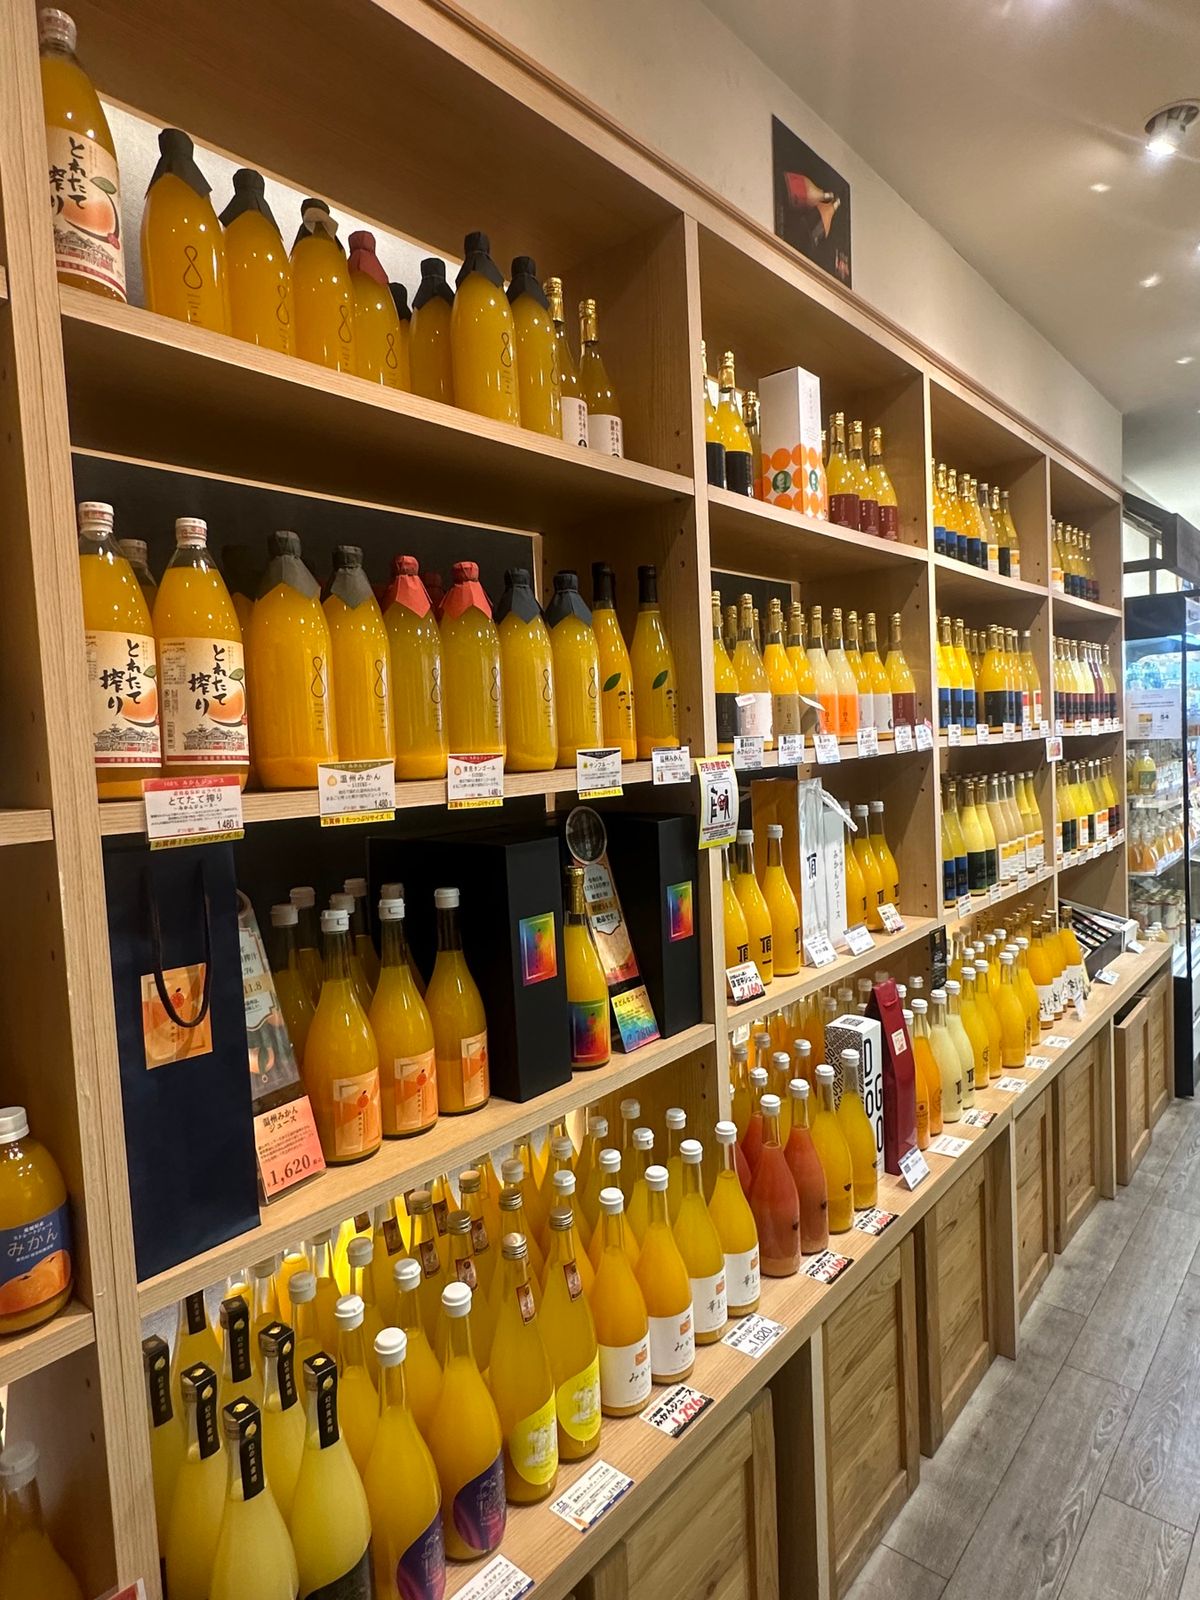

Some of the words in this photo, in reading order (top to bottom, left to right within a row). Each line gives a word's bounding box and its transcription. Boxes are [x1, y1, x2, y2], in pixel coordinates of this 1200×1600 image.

[67, 136, 88, 210] とれたて
[126, 639, 142, 705] とれたて
[212, 644, 227, 706] とれたて
[100, 668, 126, 716] 搾り
[188, 672, 212, 717] 搾り
[340, 773, 380, 783] 温州みかん
[262, 1106, 298, 1128] 温州みかん
[269, 1116, 296, 1133] ジュース
[8, 1228, 58, 1257] みかん
[748, 1326, 773, 1348] 1,620
[654, 1388, 696, 1427] みかんジュース
[671, 1396, 704, 1427] 1,296
